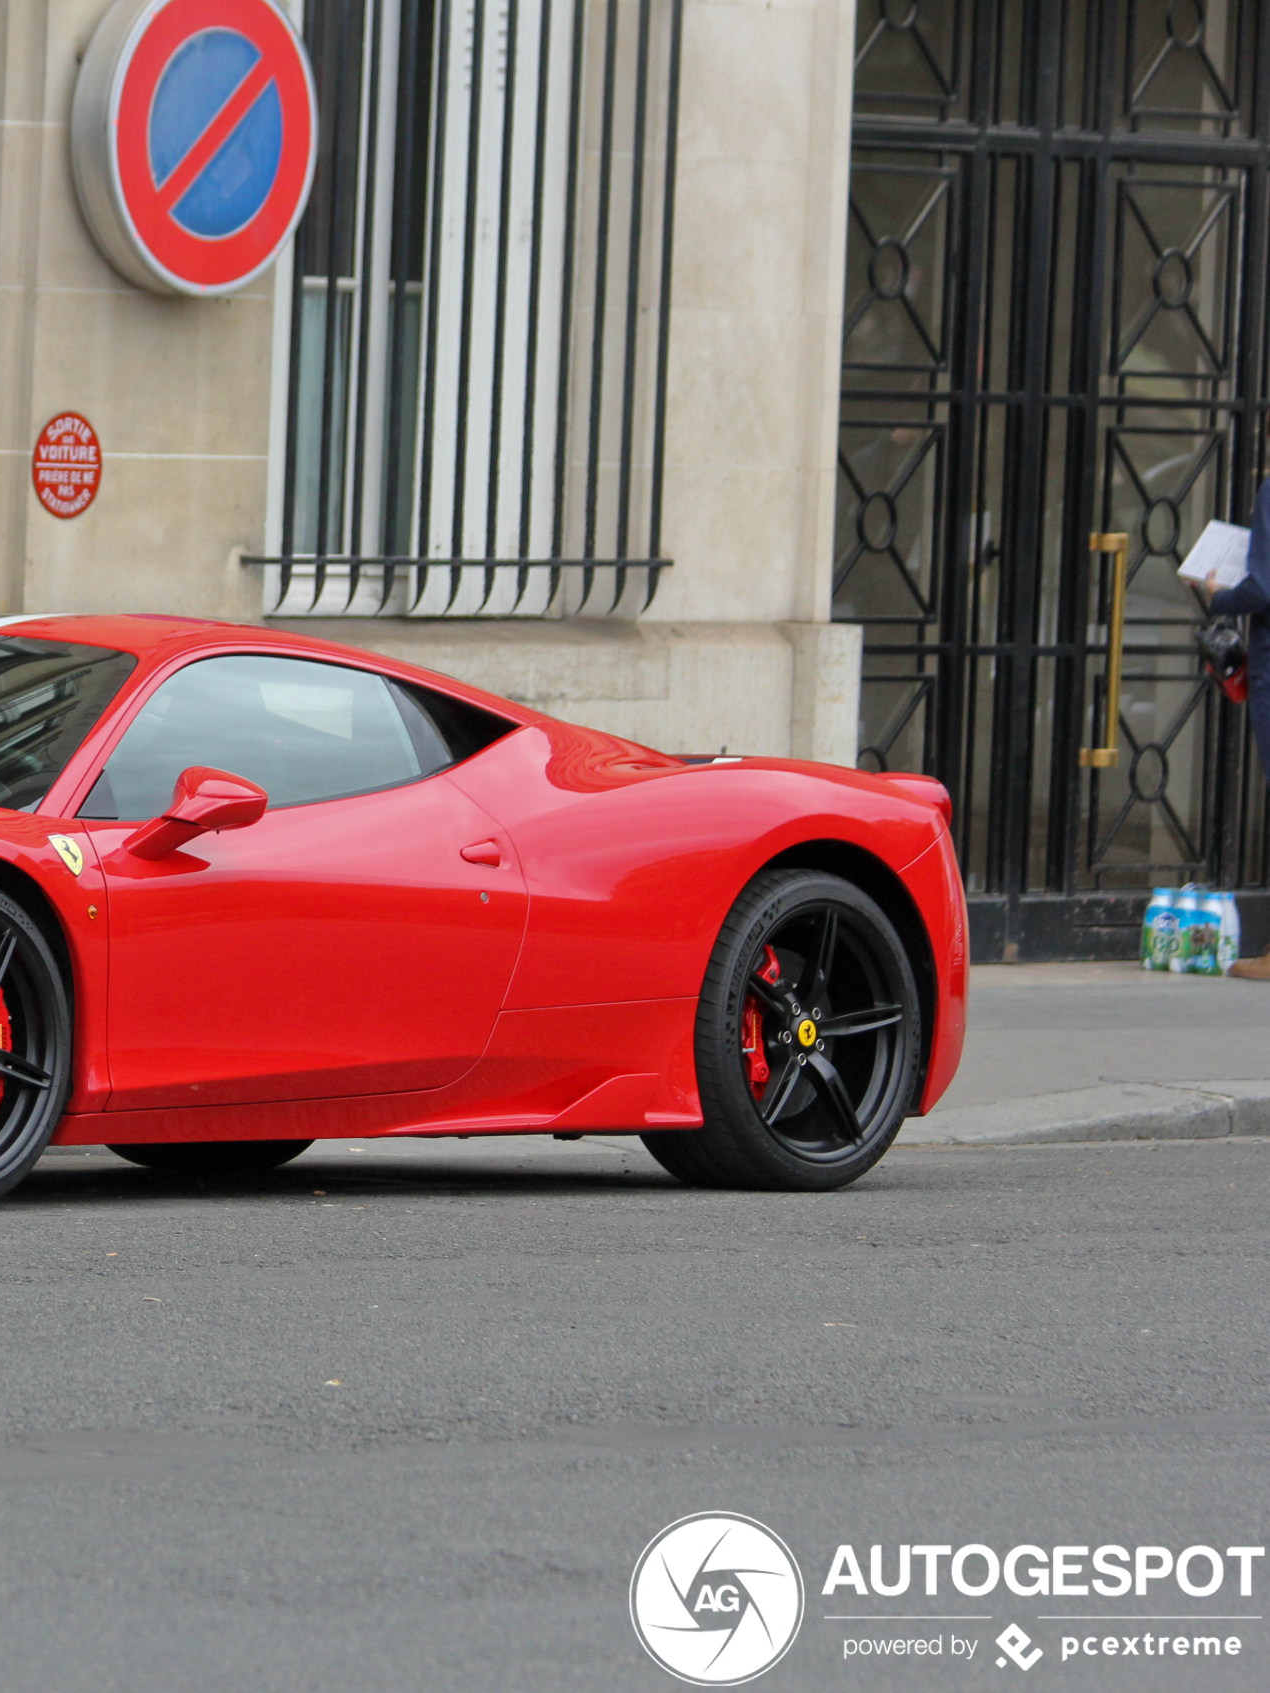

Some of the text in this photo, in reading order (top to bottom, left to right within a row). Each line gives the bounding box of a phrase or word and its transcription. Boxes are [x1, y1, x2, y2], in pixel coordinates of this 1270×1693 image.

[47, 416, 93, 443] SORTIE
[39, 445, 97, 462] VOITURE
[70, 470, 82, 484] DE
[83, 471, 95, 485] NE
[57, 485, 75, 497] PAS
[41, 487, 92, 513] STATIONNER
